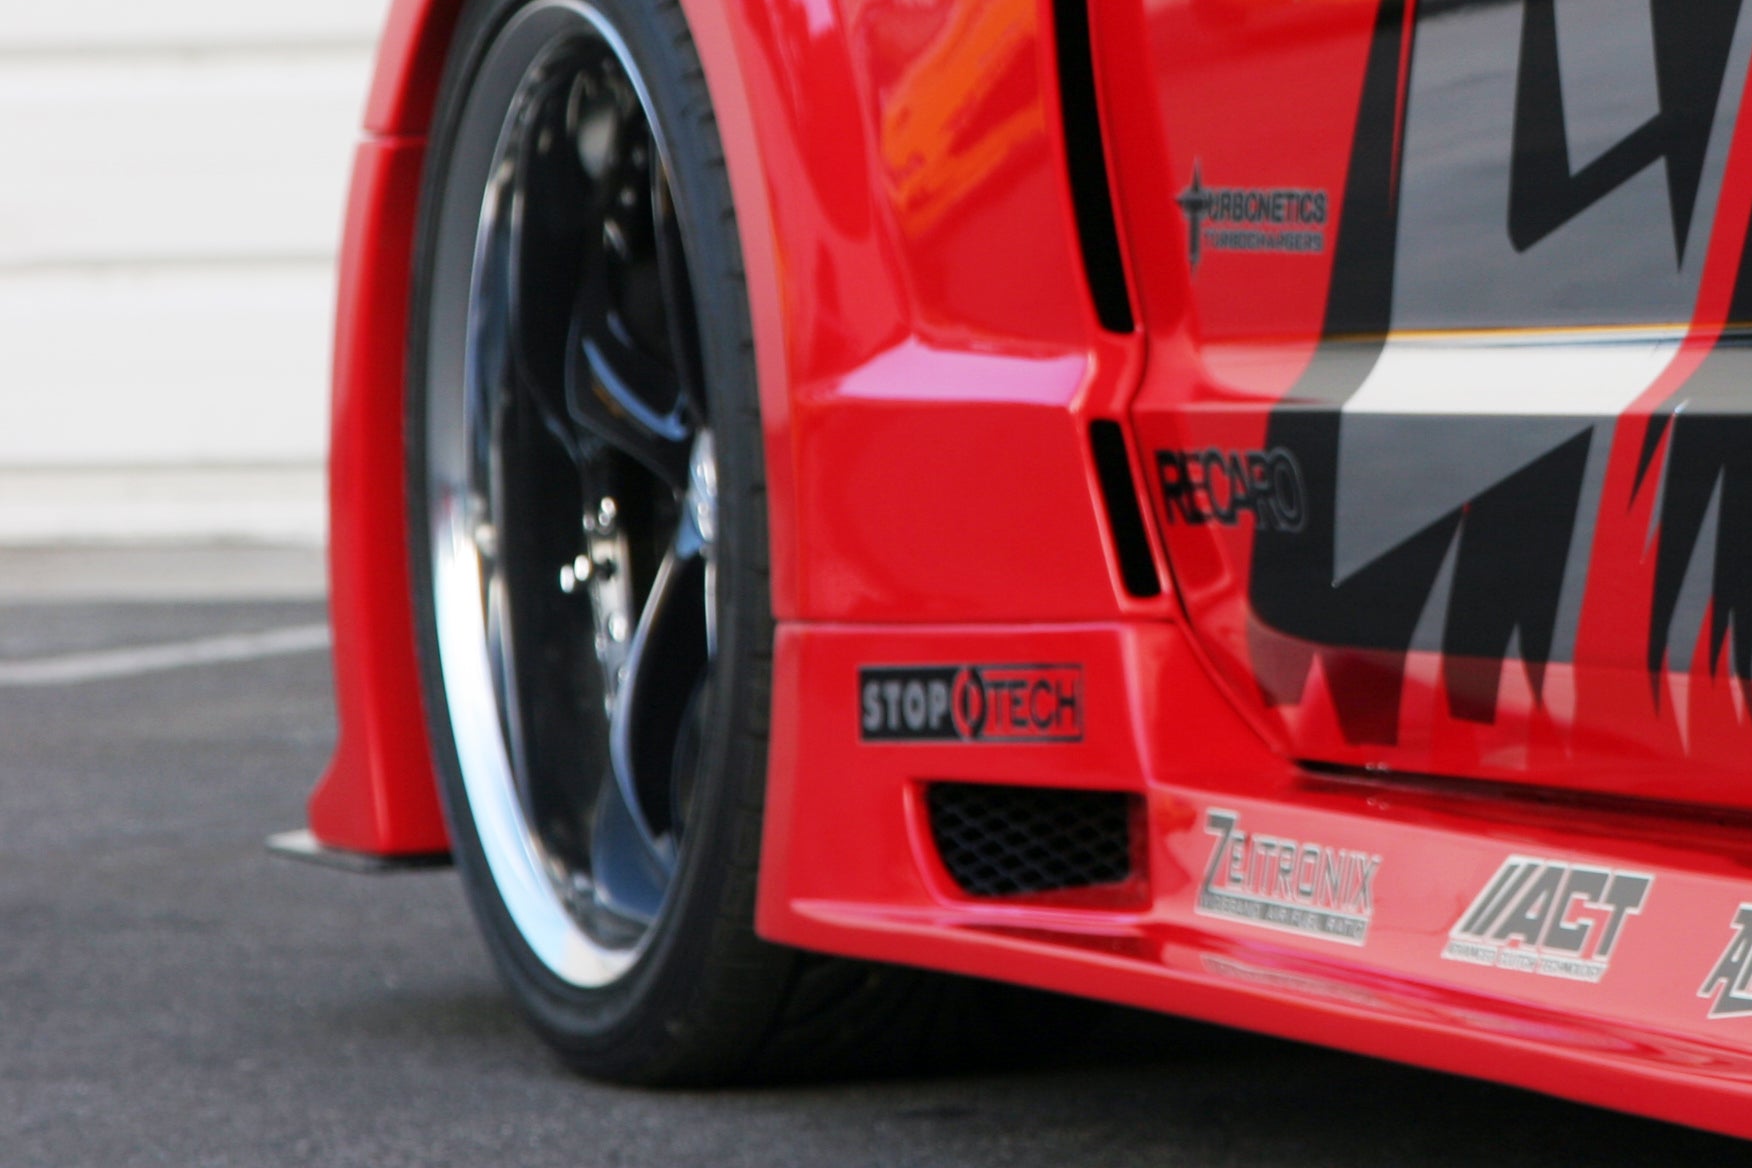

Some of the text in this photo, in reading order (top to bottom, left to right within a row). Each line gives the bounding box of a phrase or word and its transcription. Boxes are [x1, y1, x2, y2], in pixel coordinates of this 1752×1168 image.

[1155, 447, 1307, 532] RECARO
[862, 679, 1079, 731] STOP TECH
[1199, 808, 1382, 919] ZEITRONIX
